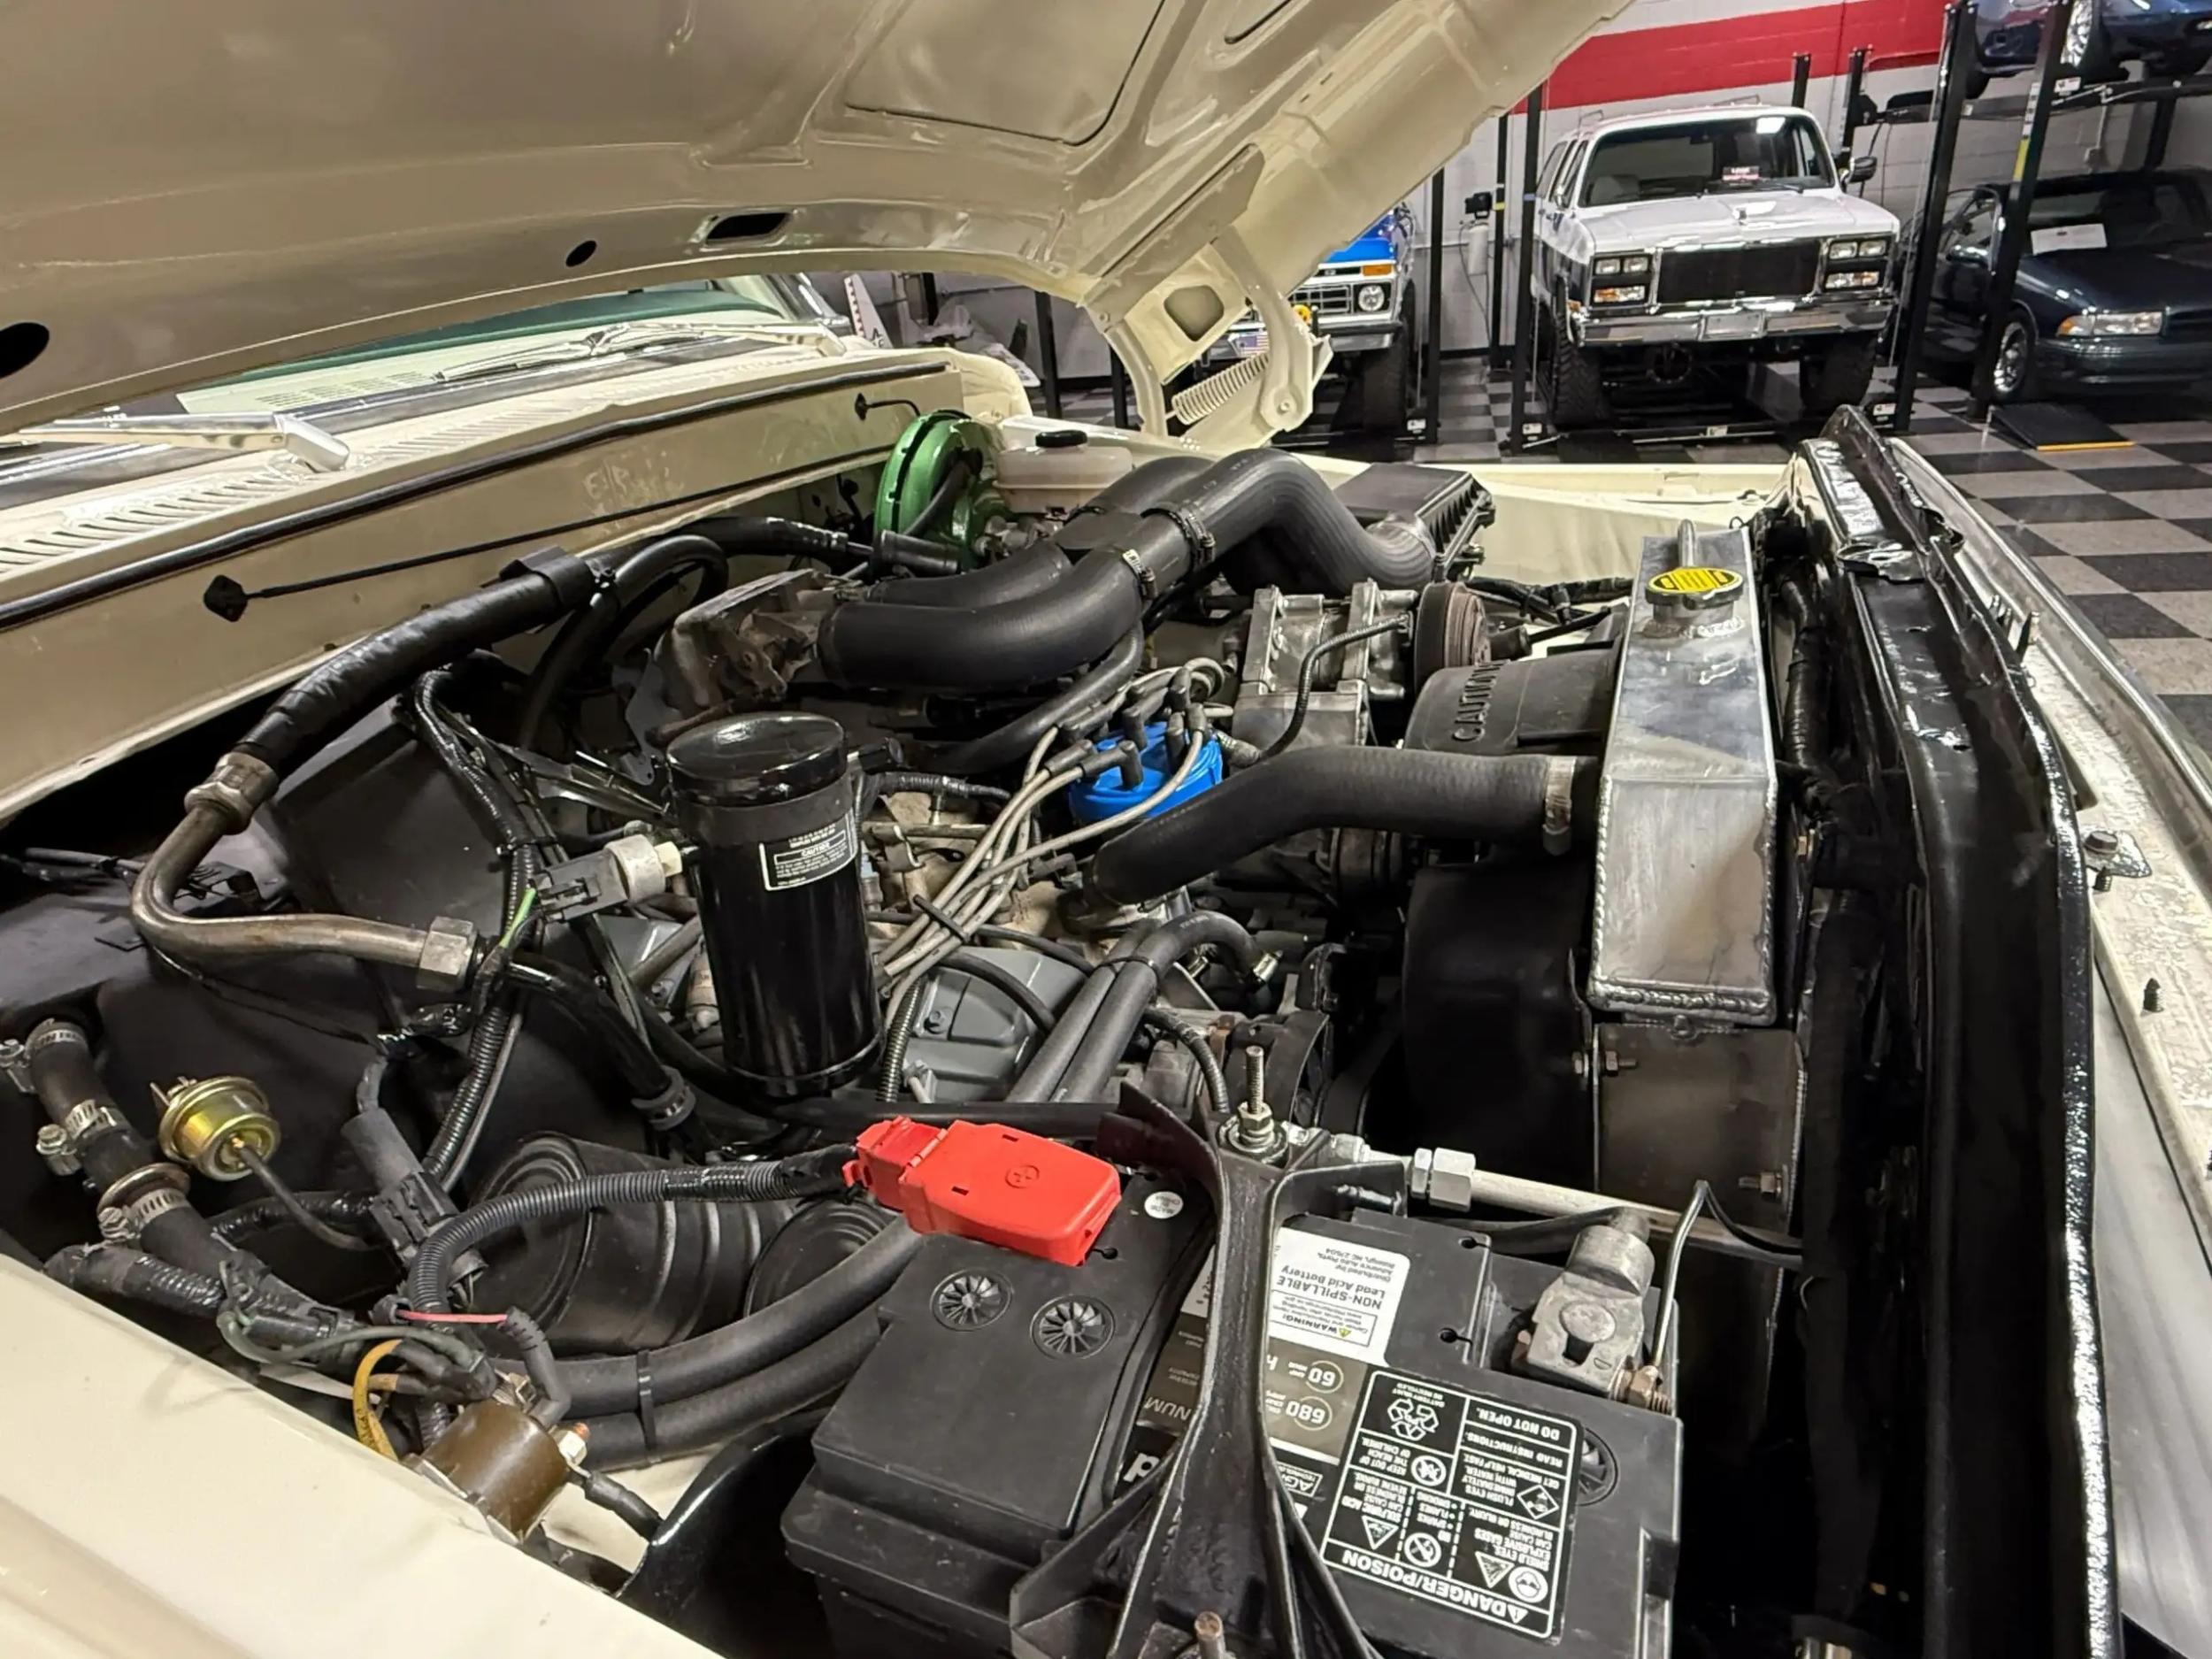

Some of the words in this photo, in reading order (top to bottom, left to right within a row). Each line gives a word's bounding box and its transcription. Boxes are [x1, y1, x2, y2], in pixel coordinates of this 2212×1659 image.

[1281, 1265, 1325, 1284] Battery
[1327, 1278, 1354, 1291] Acid
[1355, 1285, 1386, 1299] Lead
[1277, 1275, 1382, 1310] NON-SPILLABLE
[1308, 1368, 1335, 1386] 60
[1143, 1397, 1191, 1420] NUM
[1285, 1401, 1325, 1428] 680
[1477, 1408, 1512, 1427] OPEN.
[1513, 1418, 1540, 1434] NOT
[1541, 1426, 1560, 1440] DO
[1465, 1432, 1533, 1459] INSTRUCTIONS.
[1359, 1455, 1371, 1465] OF
[1368, 1449, 1393, 1462] REACH
[1394, 1456, 1407, 1466] THE
[1400, 1449, 1410, 1458] OF
[1536, 1453, 1563, 1468] READ
[1371, 1459, 1386, 1470] OUT
[1386, 1464, 1406, 1476] KEEP
[1483, 1461, 1506, 1472] HELP
[1494, 1473, 1517, 1487] WITH
[1508, 1466, 1542, 1484] MEDICAL
[1354, 1481, 1365, 1491] OR
[1381, 1480, 1407, 1495] SEVERE
[1462, 1475, 1515, 1496] IMMEDIATELY
[1543, 1478, 1559, 1489] GET
[1366, 1485, 1405, 1504] BLINDNESS
[1465, 1485, 1486, 1498] EYES
[1486, 1492, 1514, 1506] FLUSH
[1341, 1495, 1363, 1510] ACID
[1364, 1494, 1387, 1507] CAUSE
[1388, 1502, 1403, 1512] CAN
[1362, 1502, 1402, 1523] SULFURIC
[1419, 1502, 1448, 1518] FLAMES
[1417, 1513, 1447, 1529] SPARKS
[1497, 1517, 1509, 1527] OR
[1438, 1530, 1451, 1543] NO
[1474, 1528, 1503, 1547] GASES
[1509, 1530, 1533, 1545] CAUSE
[1510, 1520, 1553, 1541] BLINDNESS
[1504, 1537, 1550, 1562] EXPLOSIVE
[1535, 1538, 1552, 1550] CAN
[1518, 1553, 1549, 1571] SHIELD
[1342, 1548, 1508, 1618] DANGER/POISON
